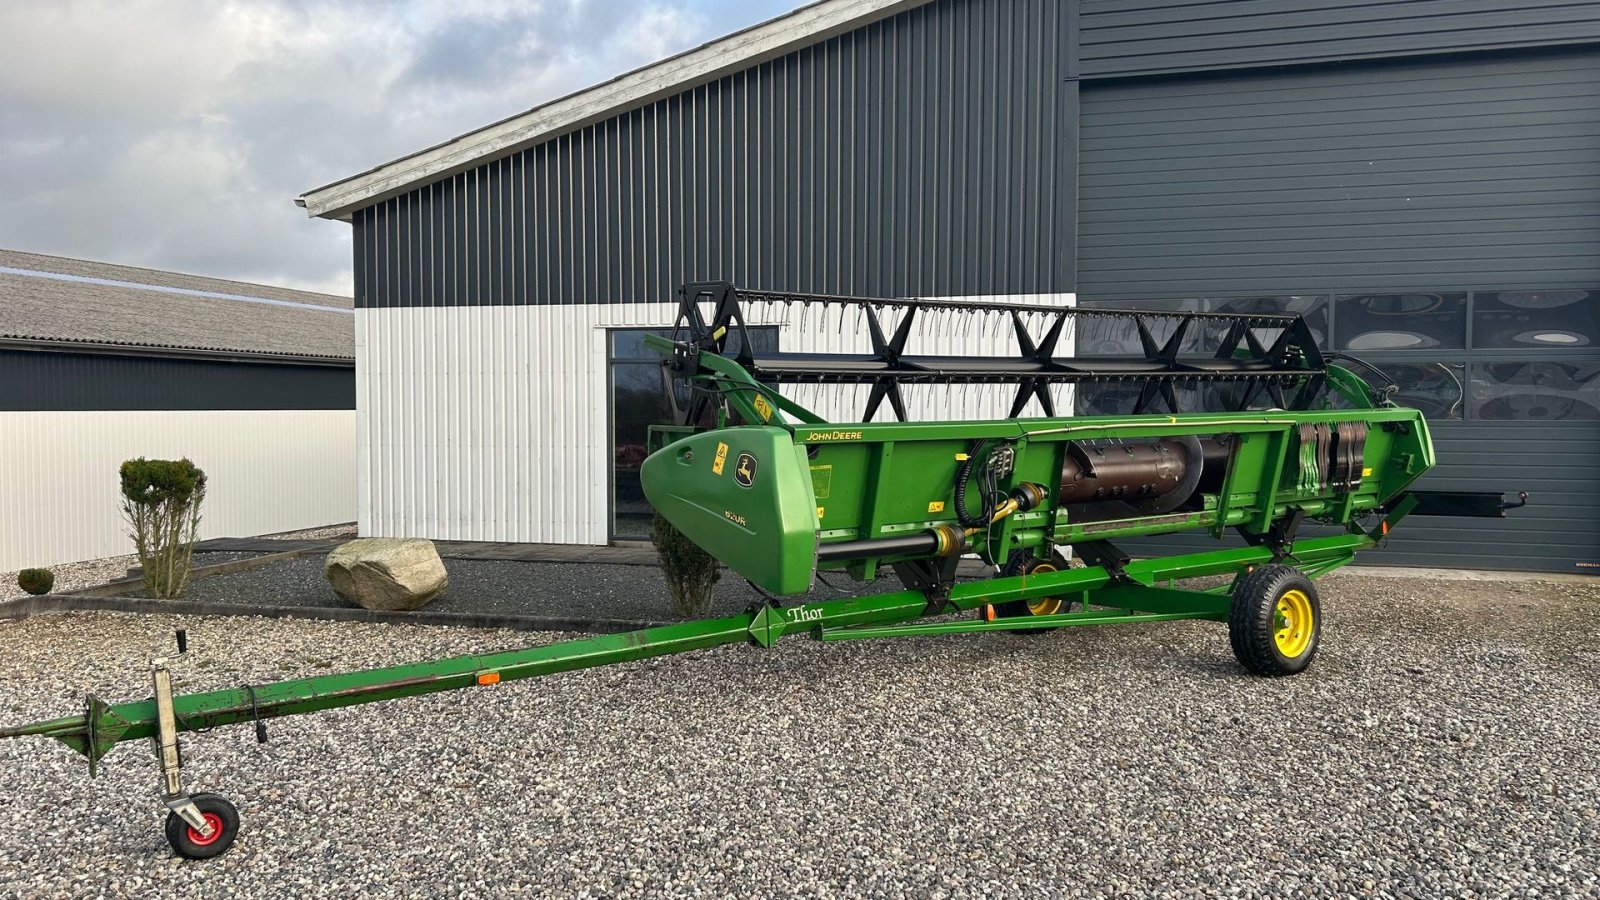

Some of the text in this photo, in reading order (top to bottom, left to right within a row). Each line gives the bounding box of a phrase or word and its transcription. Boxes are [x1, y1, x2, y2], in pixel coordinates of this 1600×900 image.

[806, 431, 862, 441] JOHN DEERE
[786, 604, 823, 622] Thor
